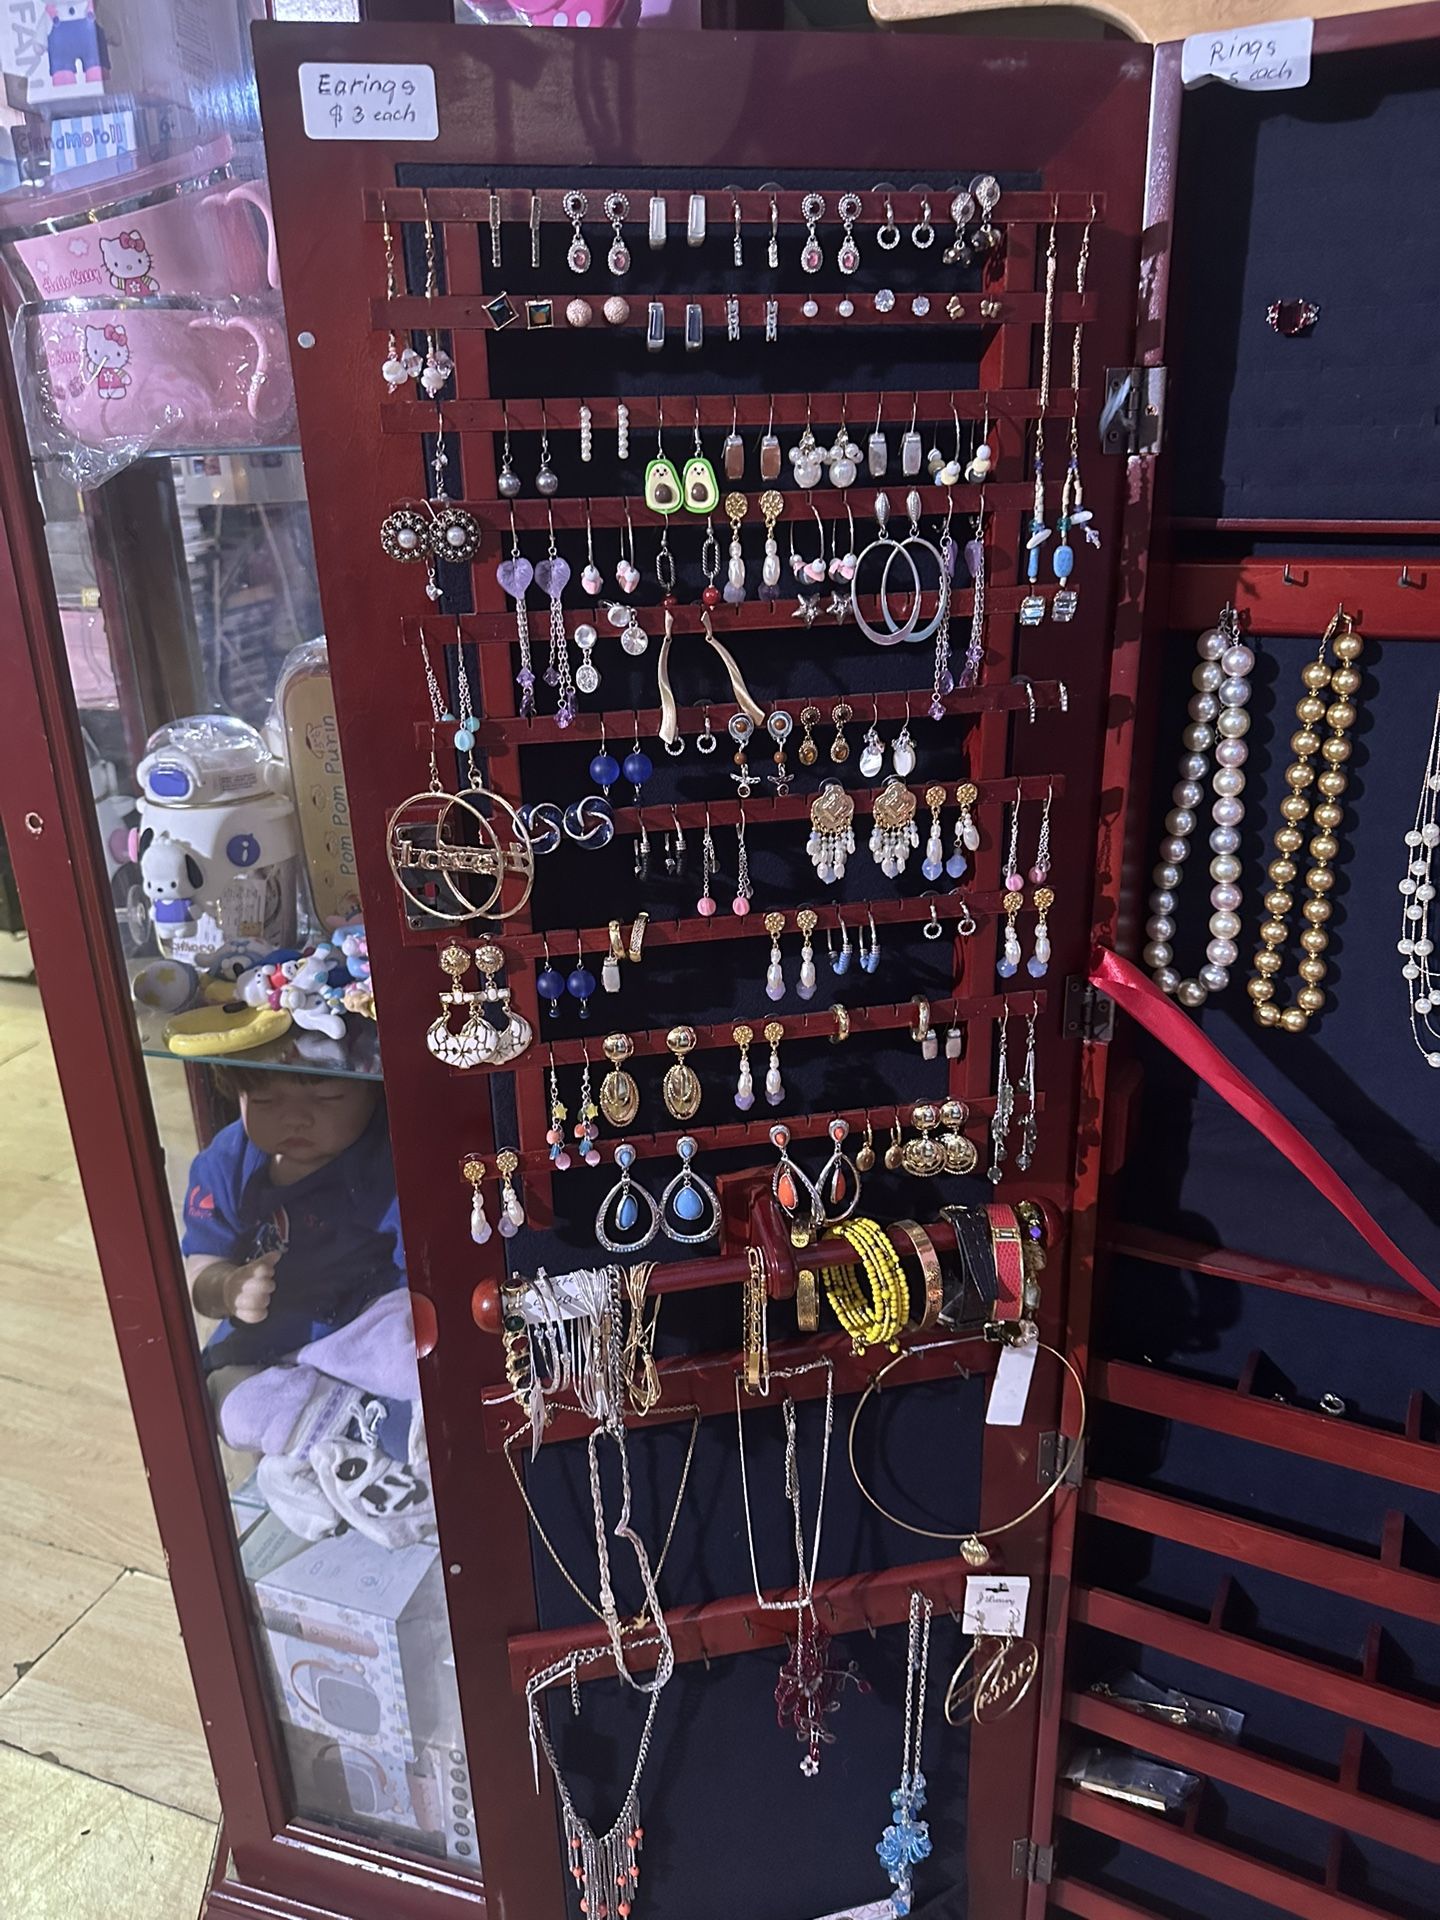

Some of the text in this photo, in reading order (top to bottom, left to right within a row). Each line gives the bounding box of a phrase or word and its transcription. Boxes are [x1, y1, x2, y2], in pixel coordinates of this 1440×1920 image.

[1210, 34, 1277, 66] Rings
[1249, 59, 1293, 81] each
[318, 73, 416, 105] Earings
[373, 103, 416, 122] each
[322, 715, 357, 876] Pom Pom Purin
